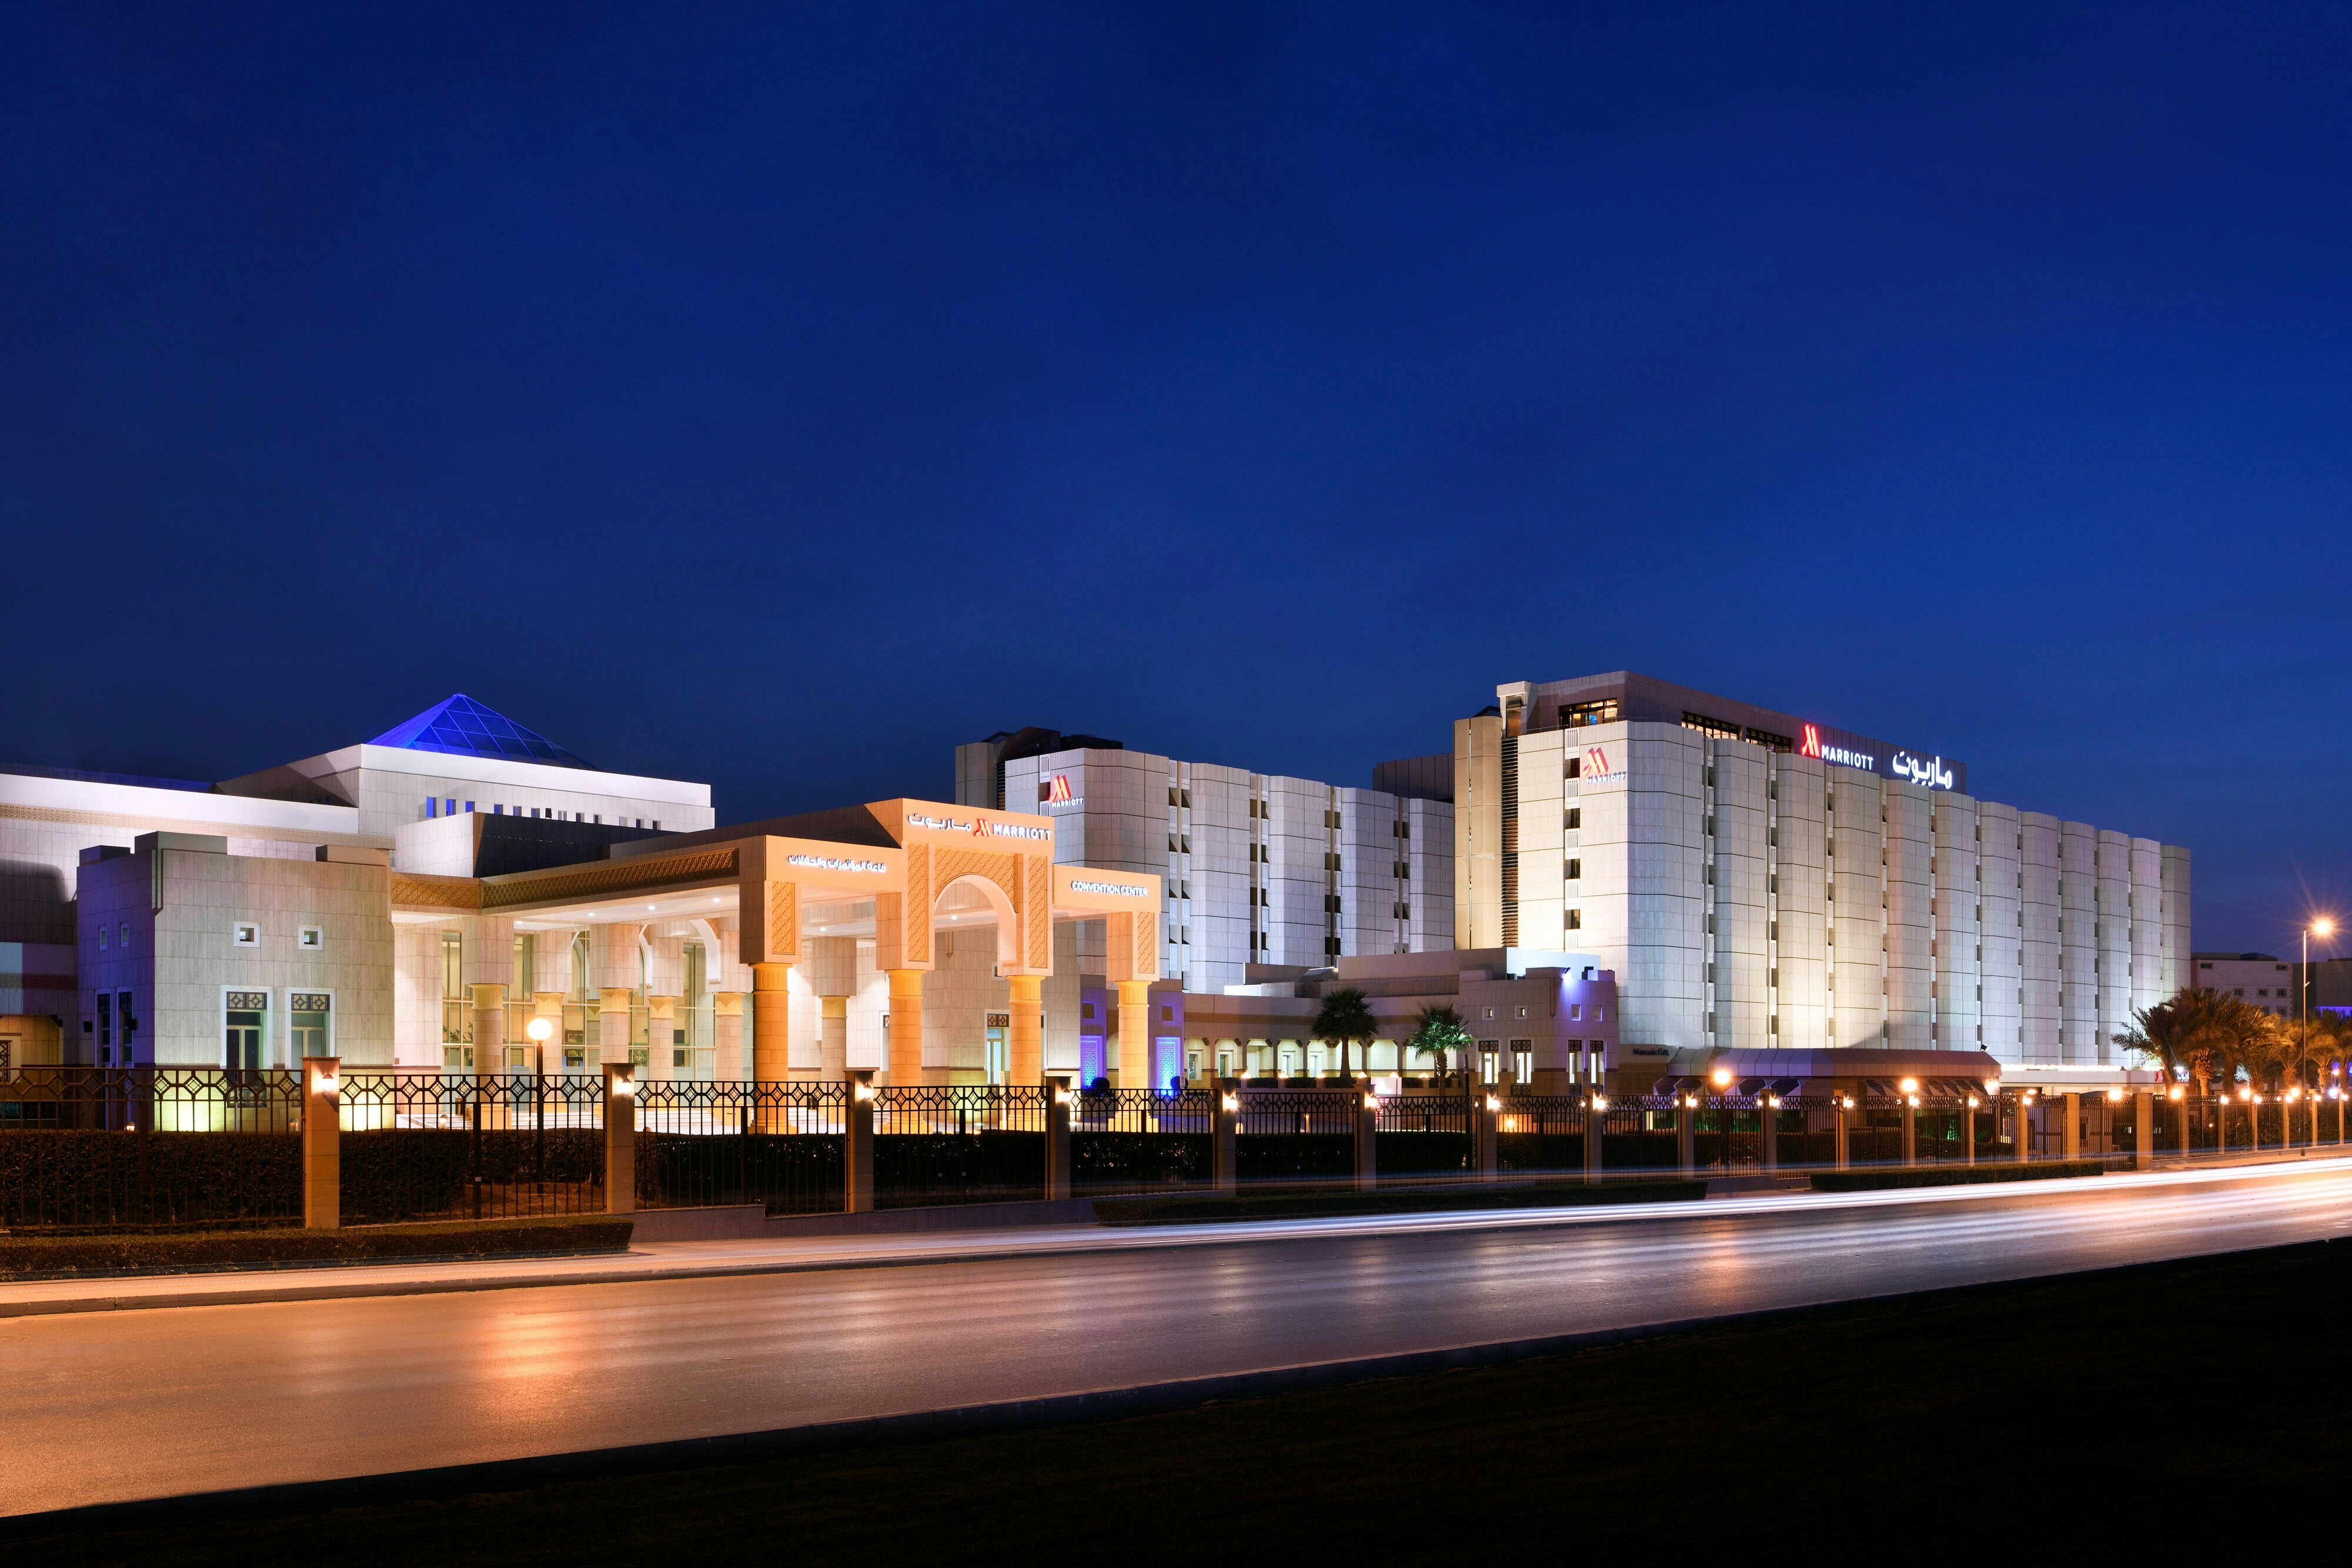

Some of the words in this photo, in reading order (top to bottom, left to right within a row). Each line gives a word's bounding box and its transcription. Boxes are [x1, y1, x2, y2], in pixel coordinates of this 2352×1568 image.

[1822, 745, 1873, 770] MARRIOTT
[1893, 751, 1952, 789] ماريوت
[1587, 773, 1626, 784] MARRIOTT
[1052, 797, 1084, 808] MARRIOTT
[908, 813, 971, 832] ماريوت
[993, 823, 1051, 840] MARRIOTT
[866, 860, 887, 872] قاعة
[1071, 881, 1120, 894] CONVENTION
[1120, 885, 1147, 897] CENTER
